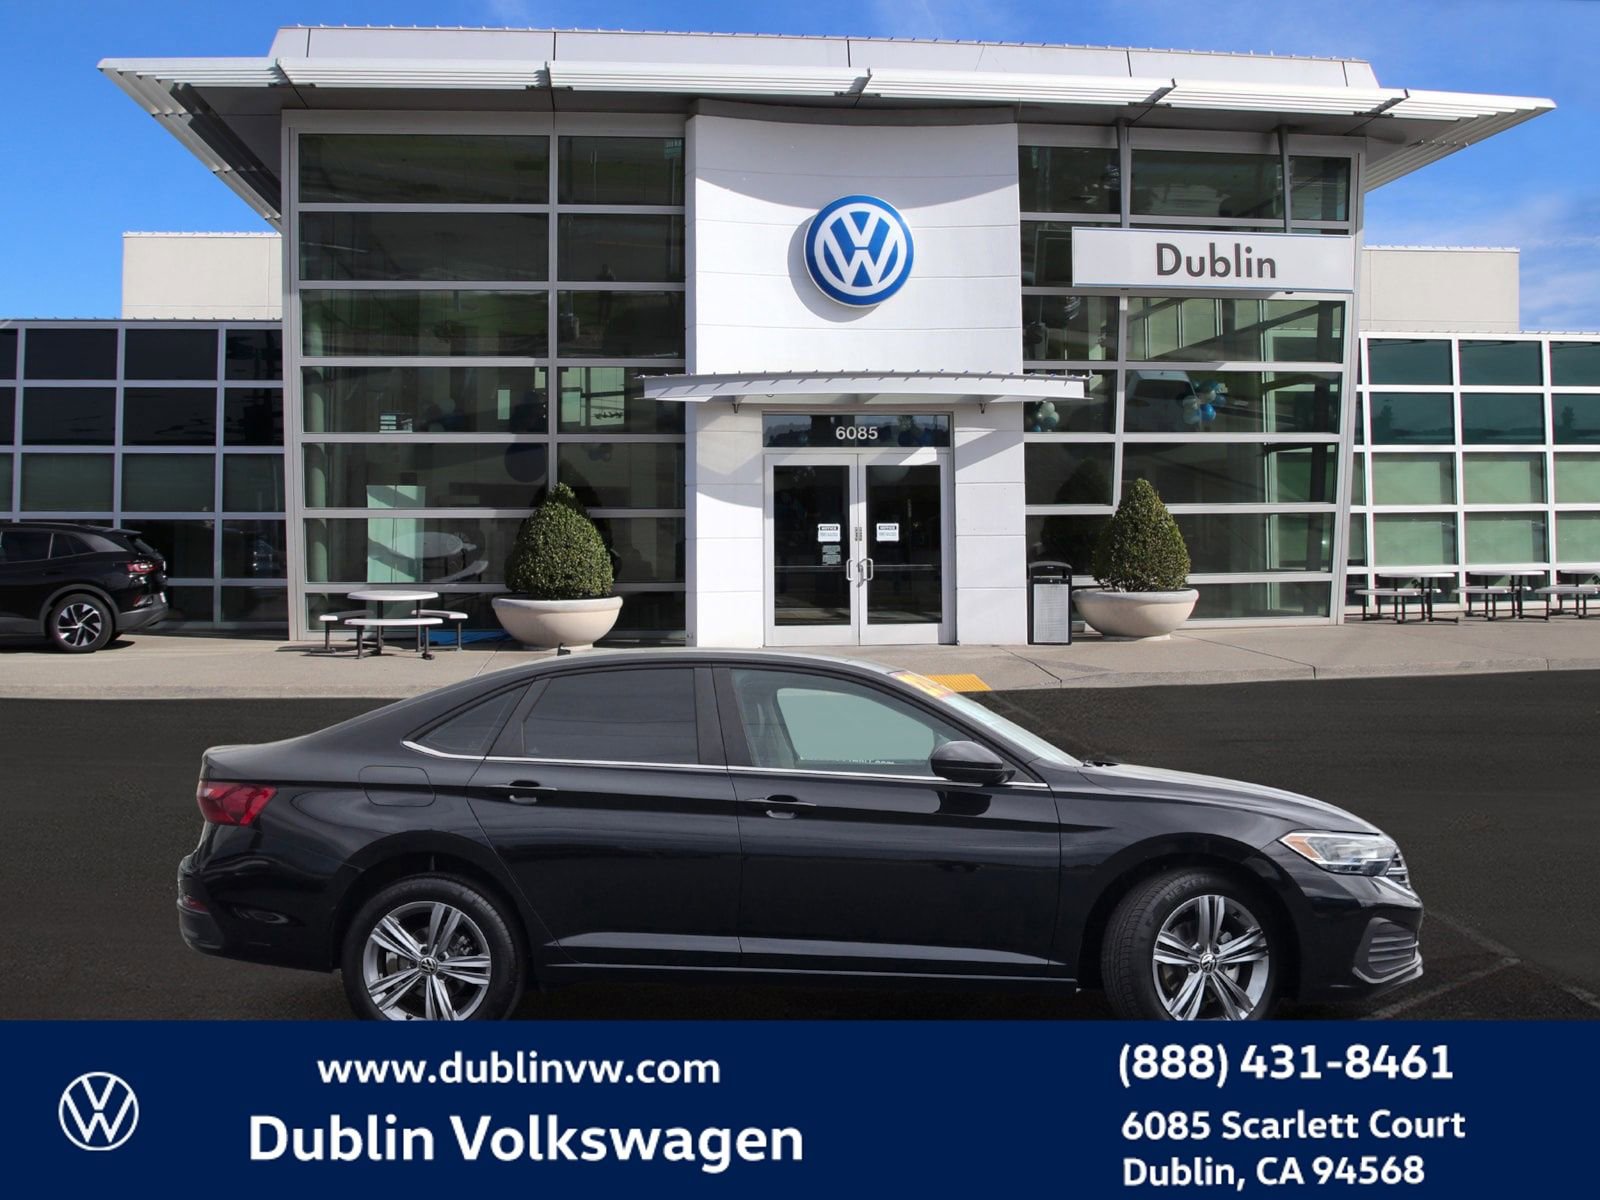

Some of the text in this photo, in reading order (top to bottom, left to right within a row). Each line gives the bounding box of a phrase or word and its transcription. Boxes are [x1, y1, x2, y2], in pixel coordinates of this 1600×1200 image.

[813, 201, 908, 297] VW
[1156, 242, 1278, 279] Dublin
[835, 425, 879, 441] 6085
